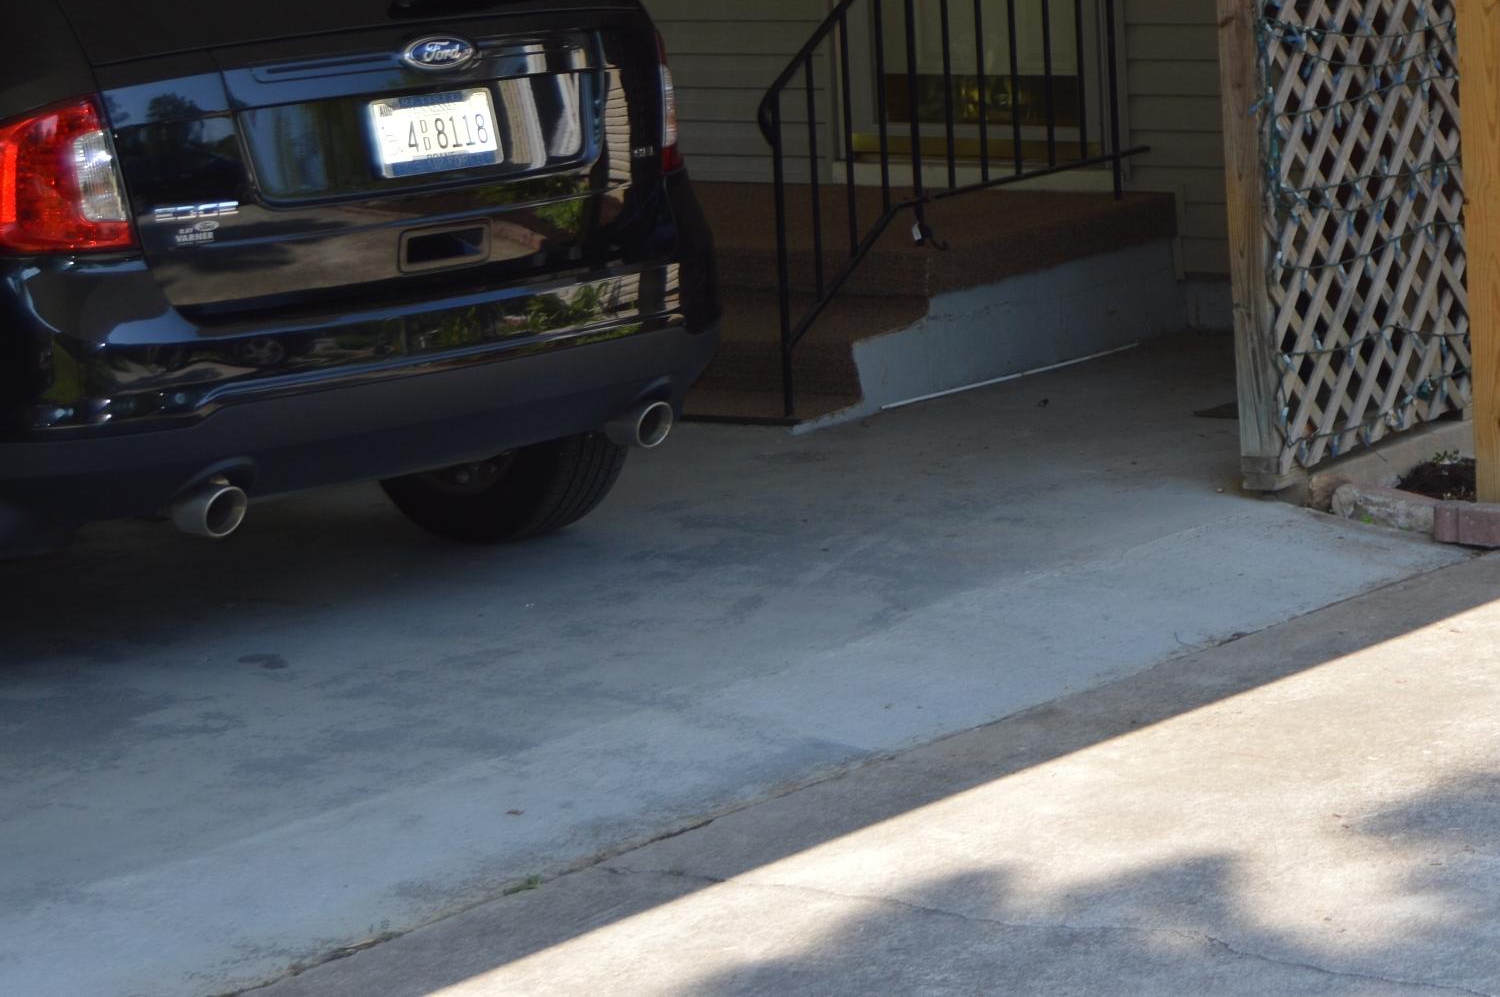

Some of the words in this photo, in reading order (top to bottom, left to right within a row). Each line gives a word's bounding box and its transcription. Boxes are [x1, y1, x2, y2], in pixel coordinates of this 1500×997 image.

[421, 41, 460, 62] Ford
[154, 201, 239, 222] EDGE
[176, 232, 214, 243] VARNER
